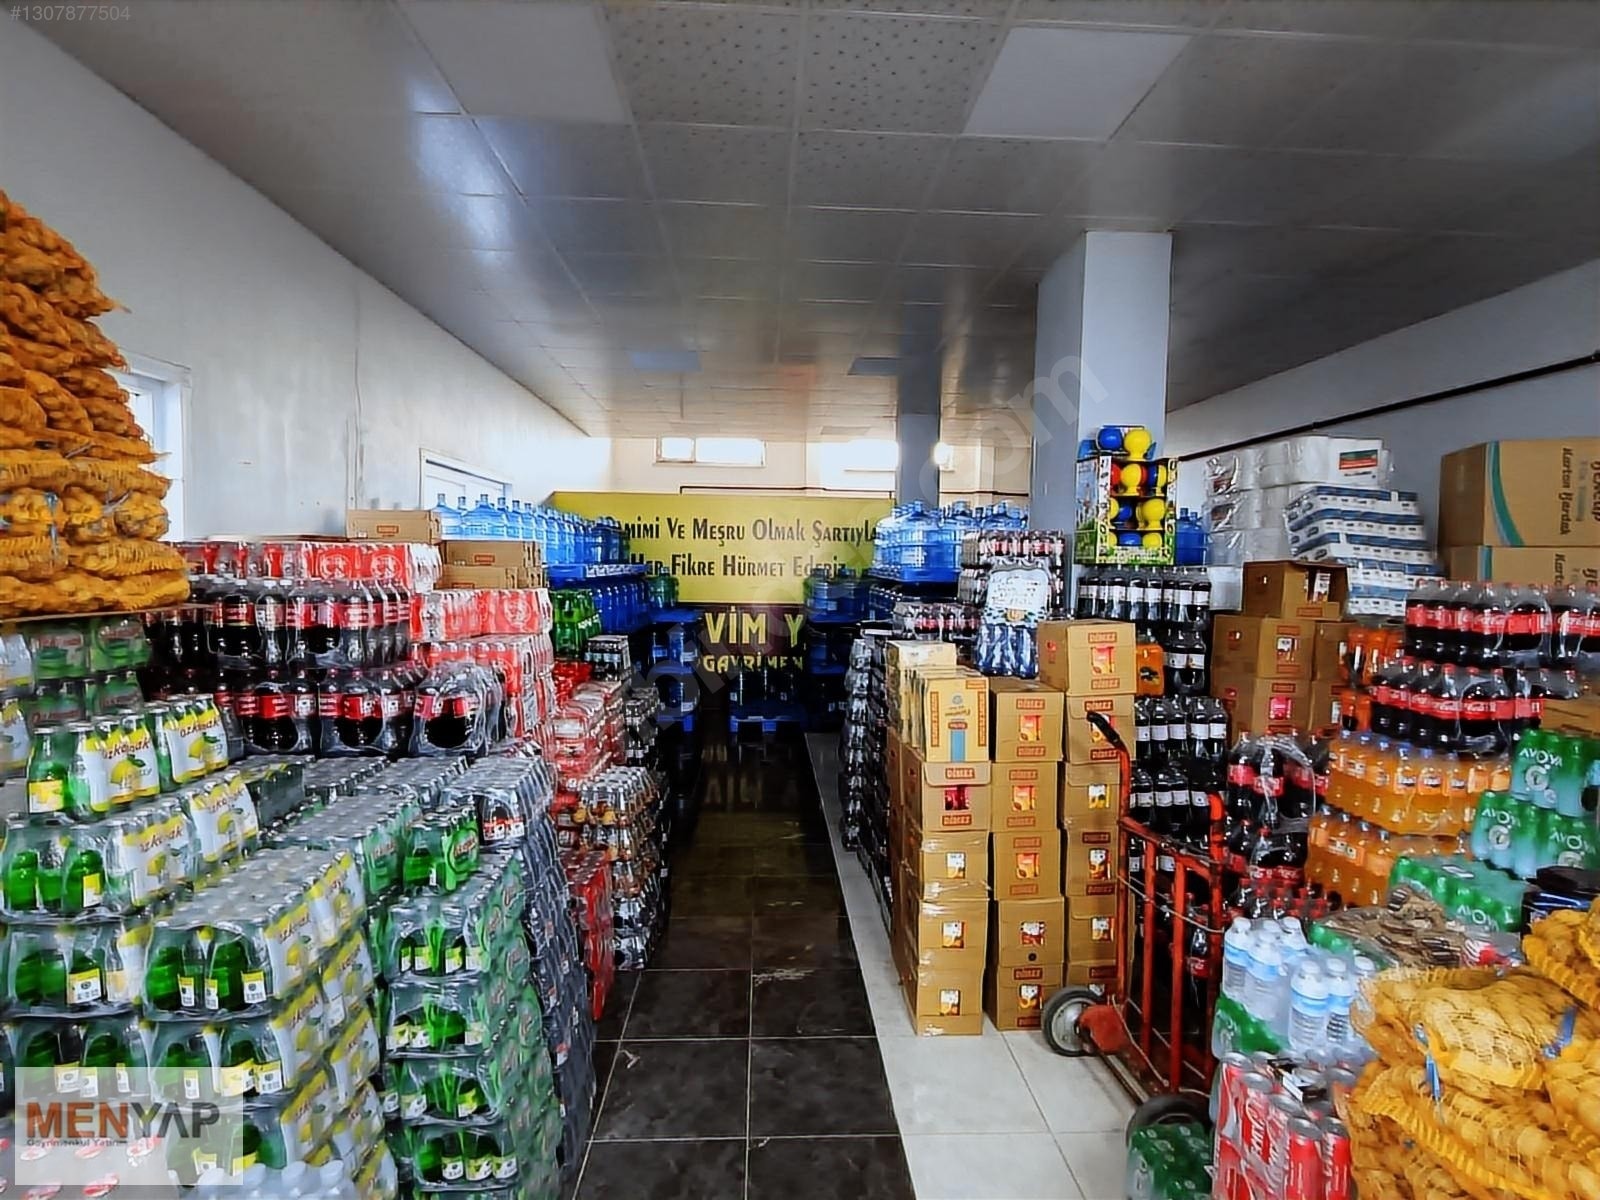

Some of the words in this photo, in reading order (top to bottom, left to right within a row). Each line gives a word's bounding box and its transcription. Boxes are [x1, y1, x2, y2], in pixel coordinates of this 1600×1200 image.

[667, 517, 685, 538] Ve
[671, 554, 716, 577] Fikre
[722, 553, 786, 577] Hürmet
